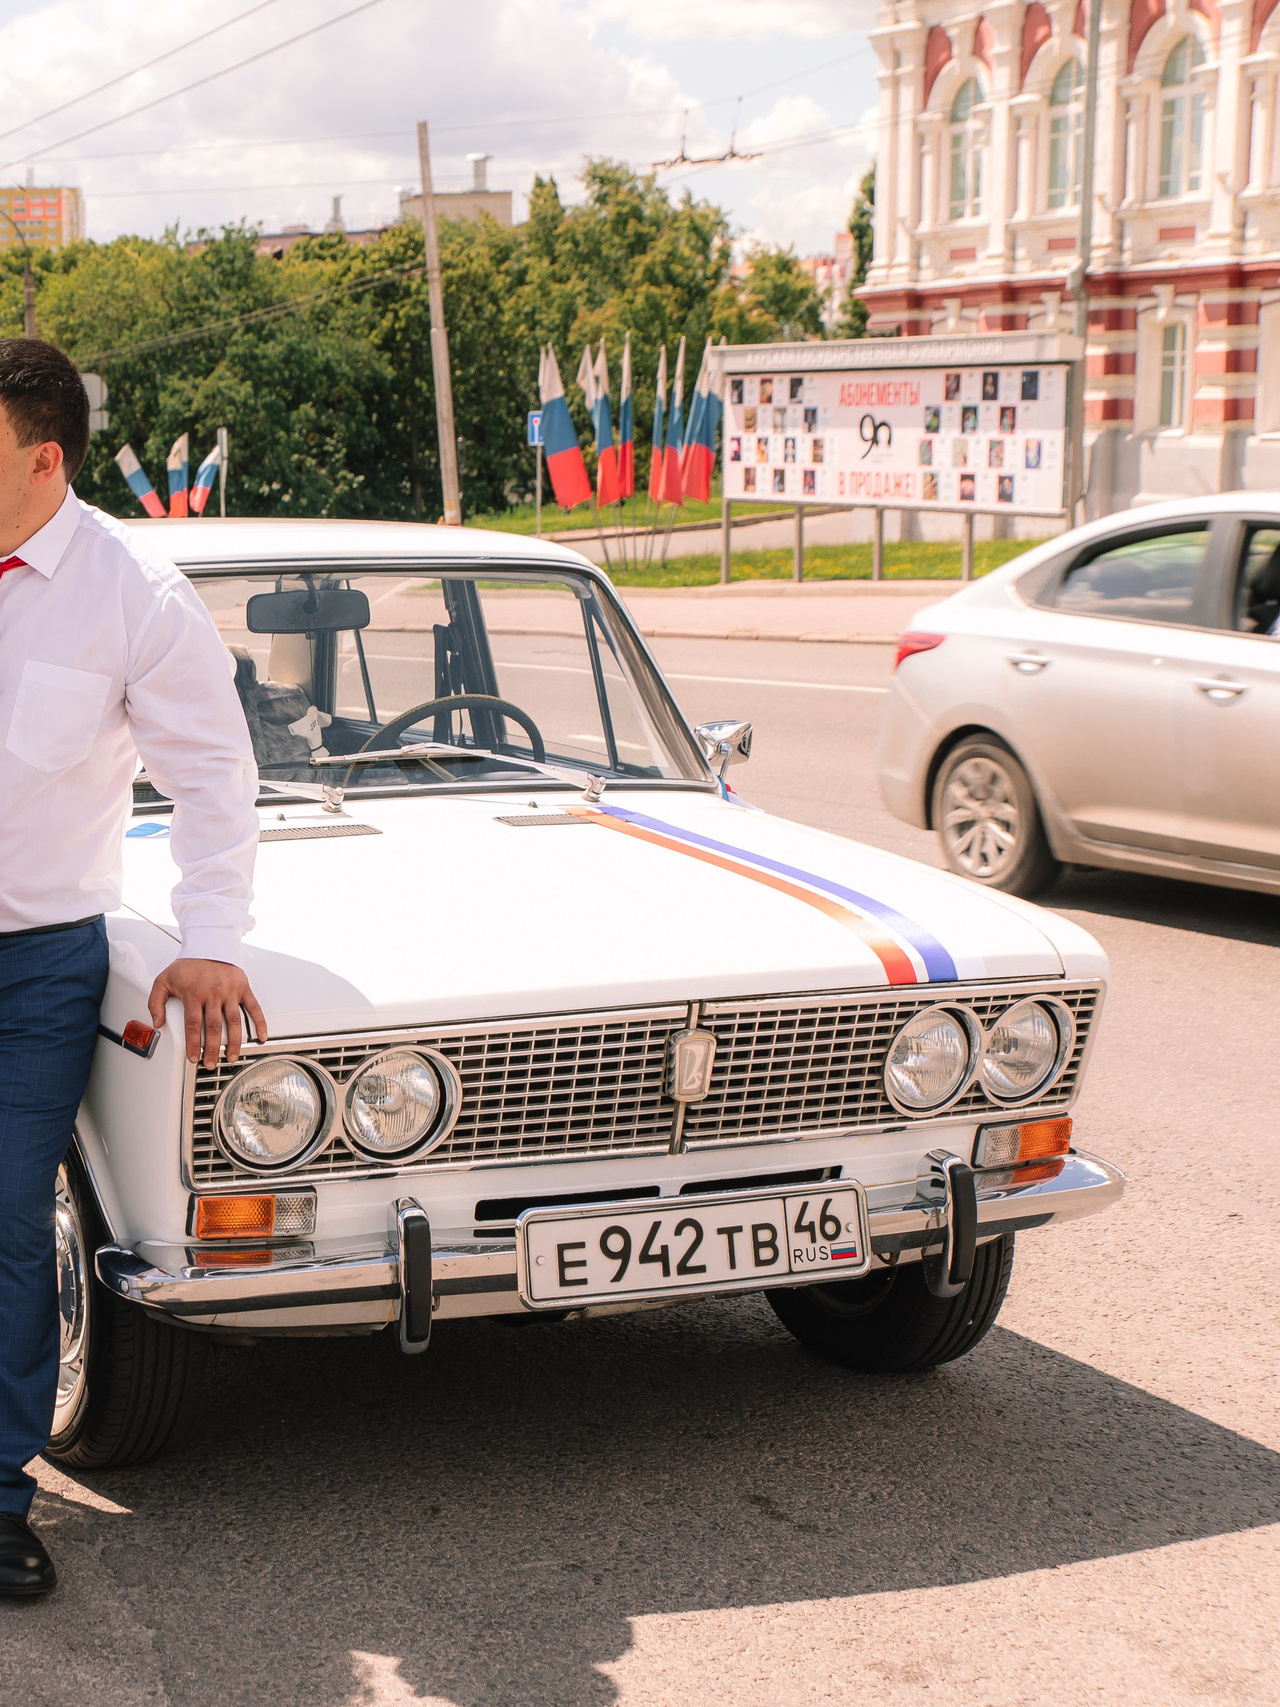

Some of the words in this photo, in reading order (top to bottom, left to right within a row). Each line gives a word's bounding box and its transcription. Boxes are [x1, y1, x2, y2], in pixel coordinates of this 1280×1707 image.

[839, 381, 920, 406] АБОНЕМЕНТЫ
[838, 471, 846, 496] В
[849, 471, 917, 498] ПРОДАЖЕ!
[794, 1198, 841, 1244] 46
[793, 1245, 829, 1264] RUS
